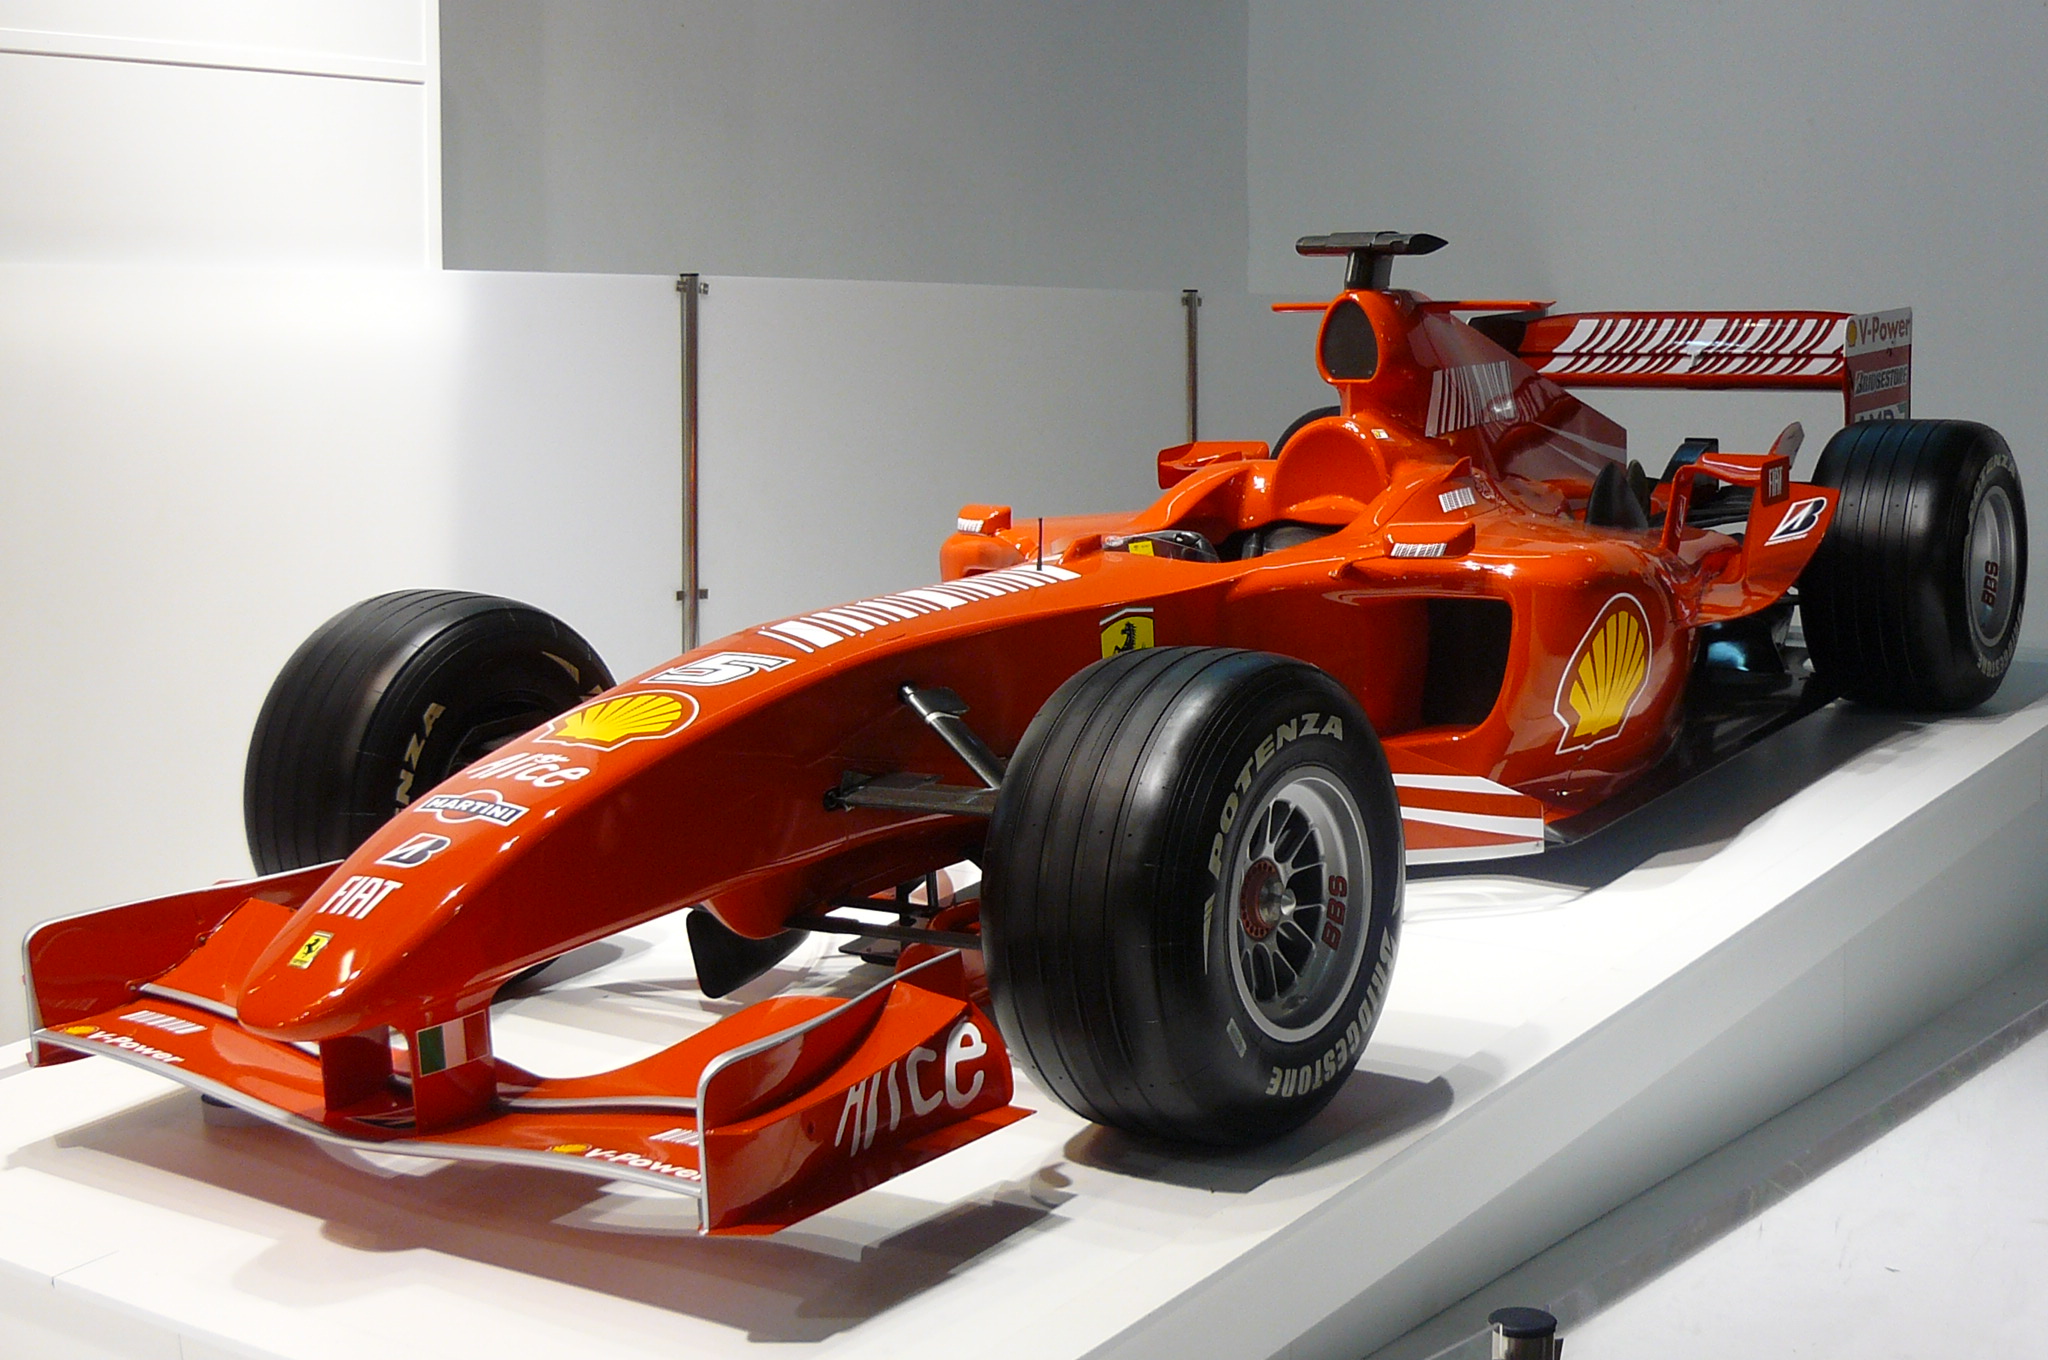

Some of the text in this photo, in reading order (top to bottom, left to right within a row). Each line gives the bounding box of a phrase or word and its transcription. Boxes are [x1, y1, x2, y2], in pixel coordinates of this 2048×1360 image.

[1859, 316, 1911, 345] V-Power
[1980, 560, 1999, 609] BBS
[638, 651, 797, 687] 5
[426, 797, 516, 821] MARTINI
[1208, 712, 1344, 880] POTENZA
[316, 875, 404, 920] FIAT
[1321, 874, 1348, 951] BBS
[1265, 925, 1397, 1098] BRIDGESTONE
[86, 1030, 185, 1064] V-Power
